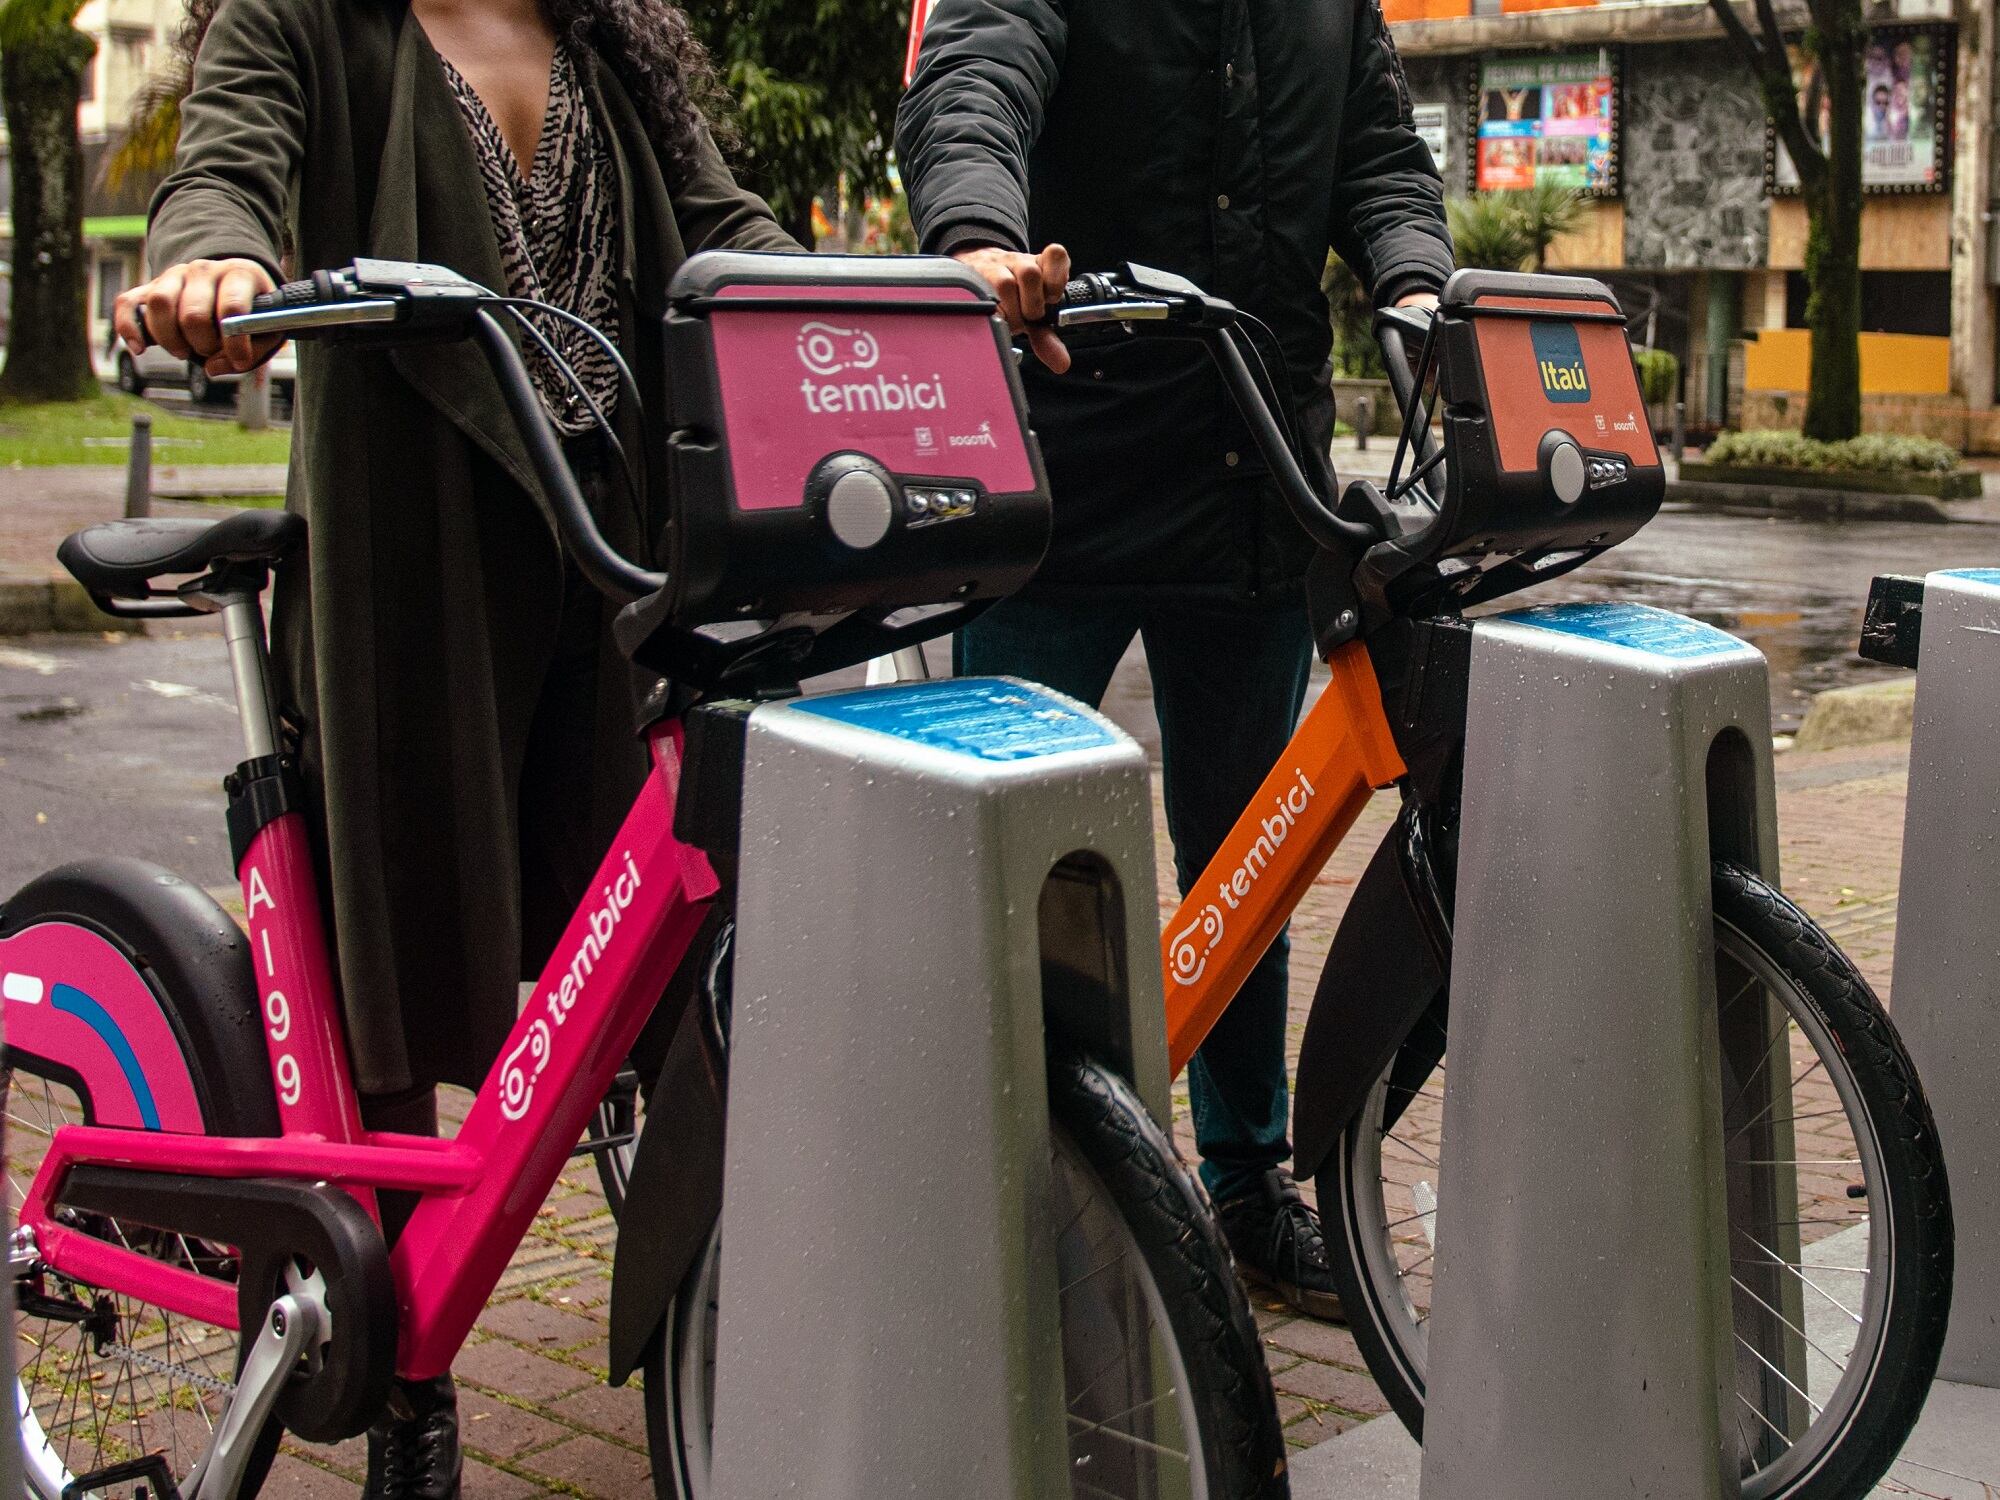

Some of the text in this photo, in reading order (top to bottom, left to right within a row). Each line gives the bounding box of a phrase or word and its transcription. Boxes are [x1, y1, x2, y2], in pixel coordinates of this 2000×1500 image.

[800, 373, 946, 413] tembici
[1540, 361, 1587, 390] Itaú
[1219, 767, 1315, 910] tembici
[547, 850, 642, 1026] tembici
